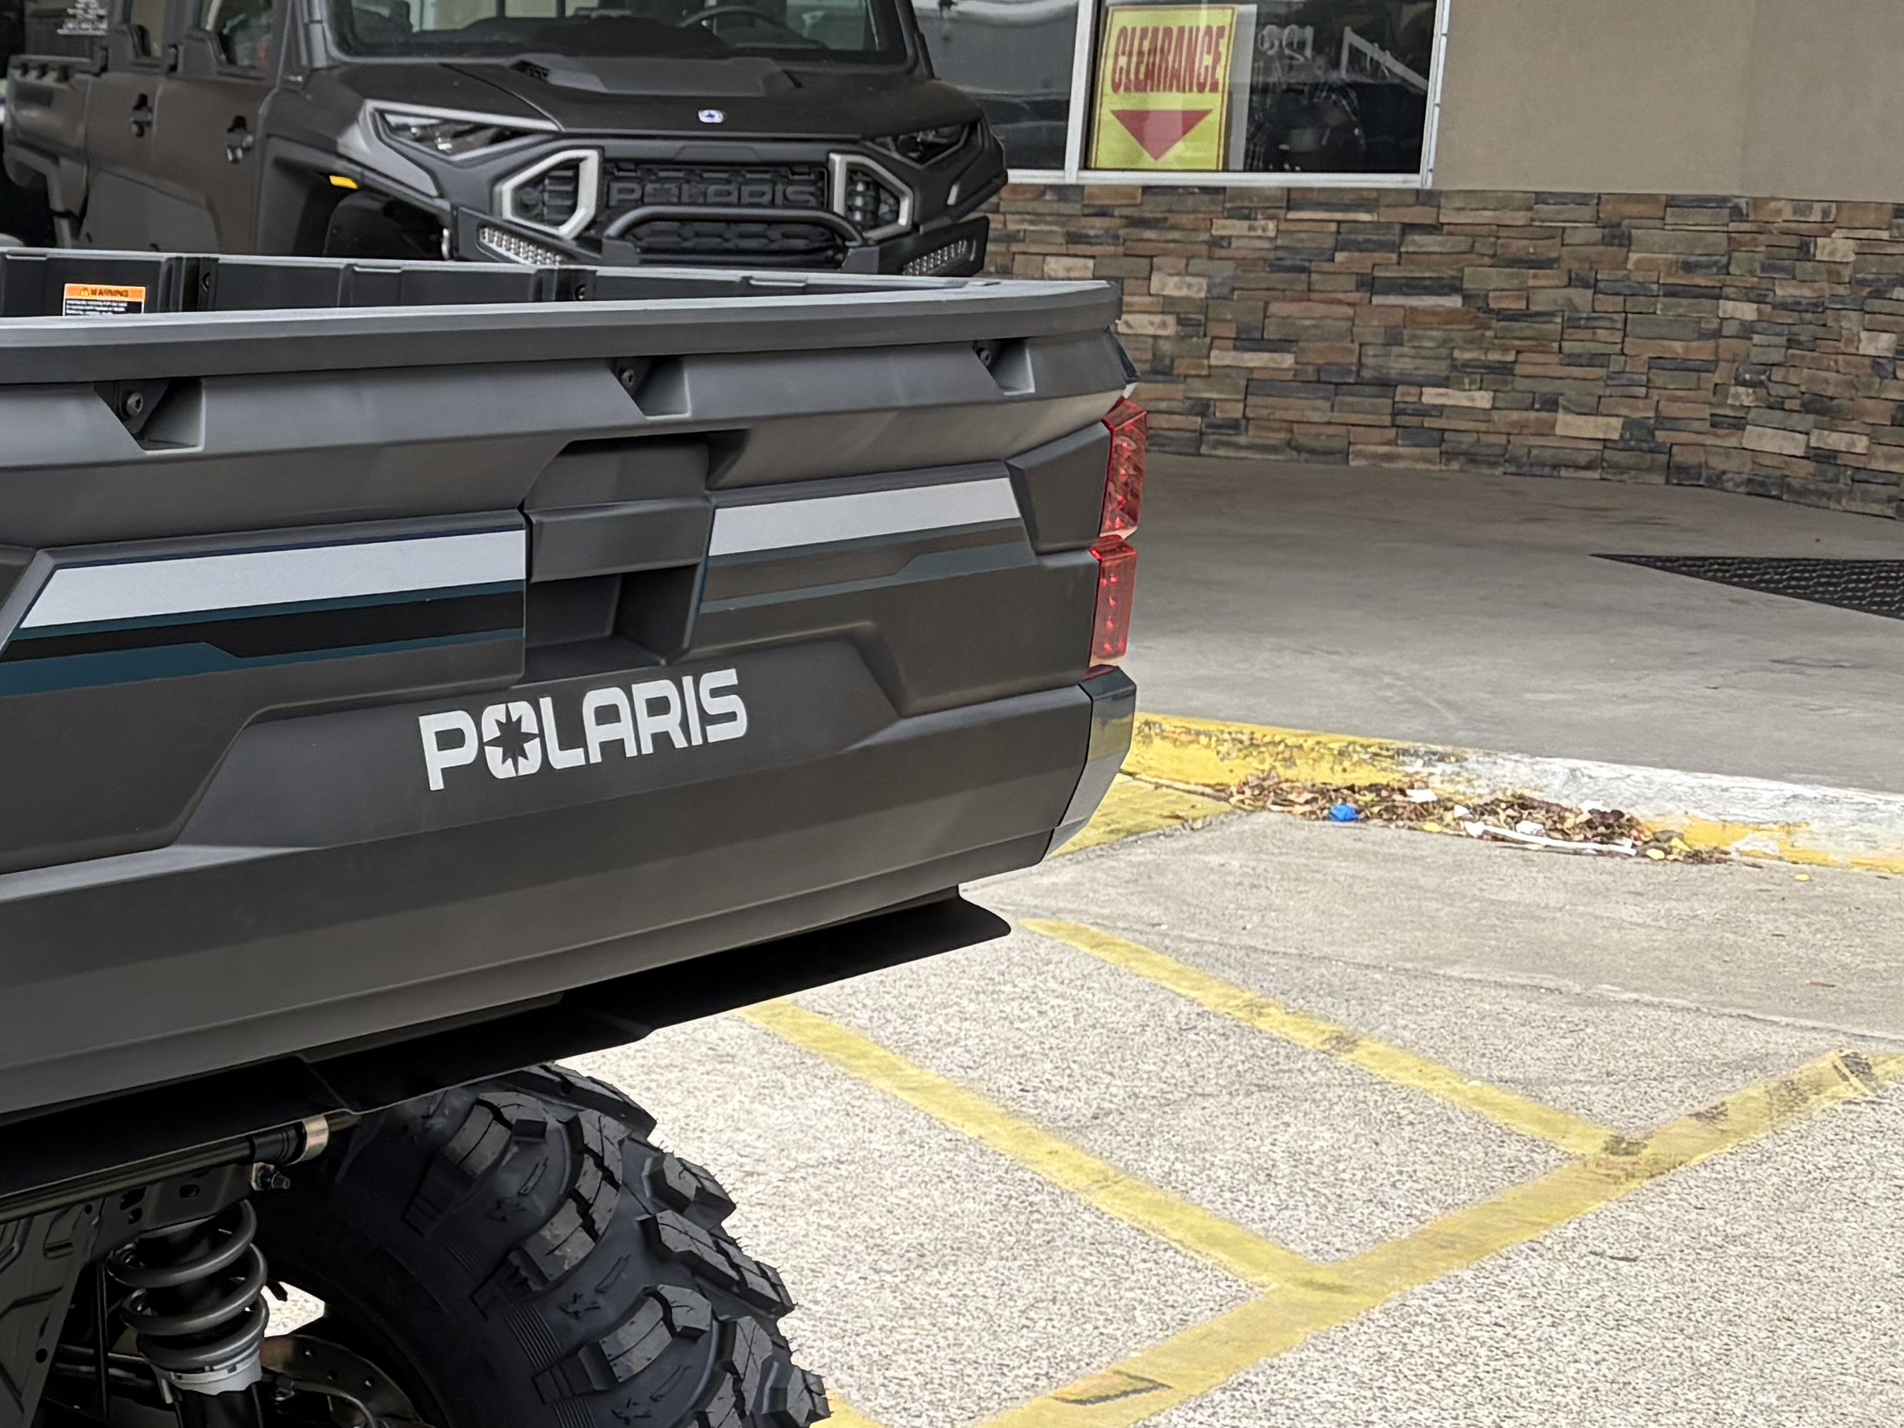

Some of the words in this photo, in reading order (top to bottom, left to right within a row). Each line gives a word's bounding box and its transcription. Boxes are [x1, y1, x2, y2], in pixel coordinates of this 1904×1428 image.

[1111, 25, 1225, 94] CLEARANCE
[608, 181, 818, 207] POLARIS
[90, 287, 129, 298] WARNING
[418, 668, 749, 792] POLARIS
